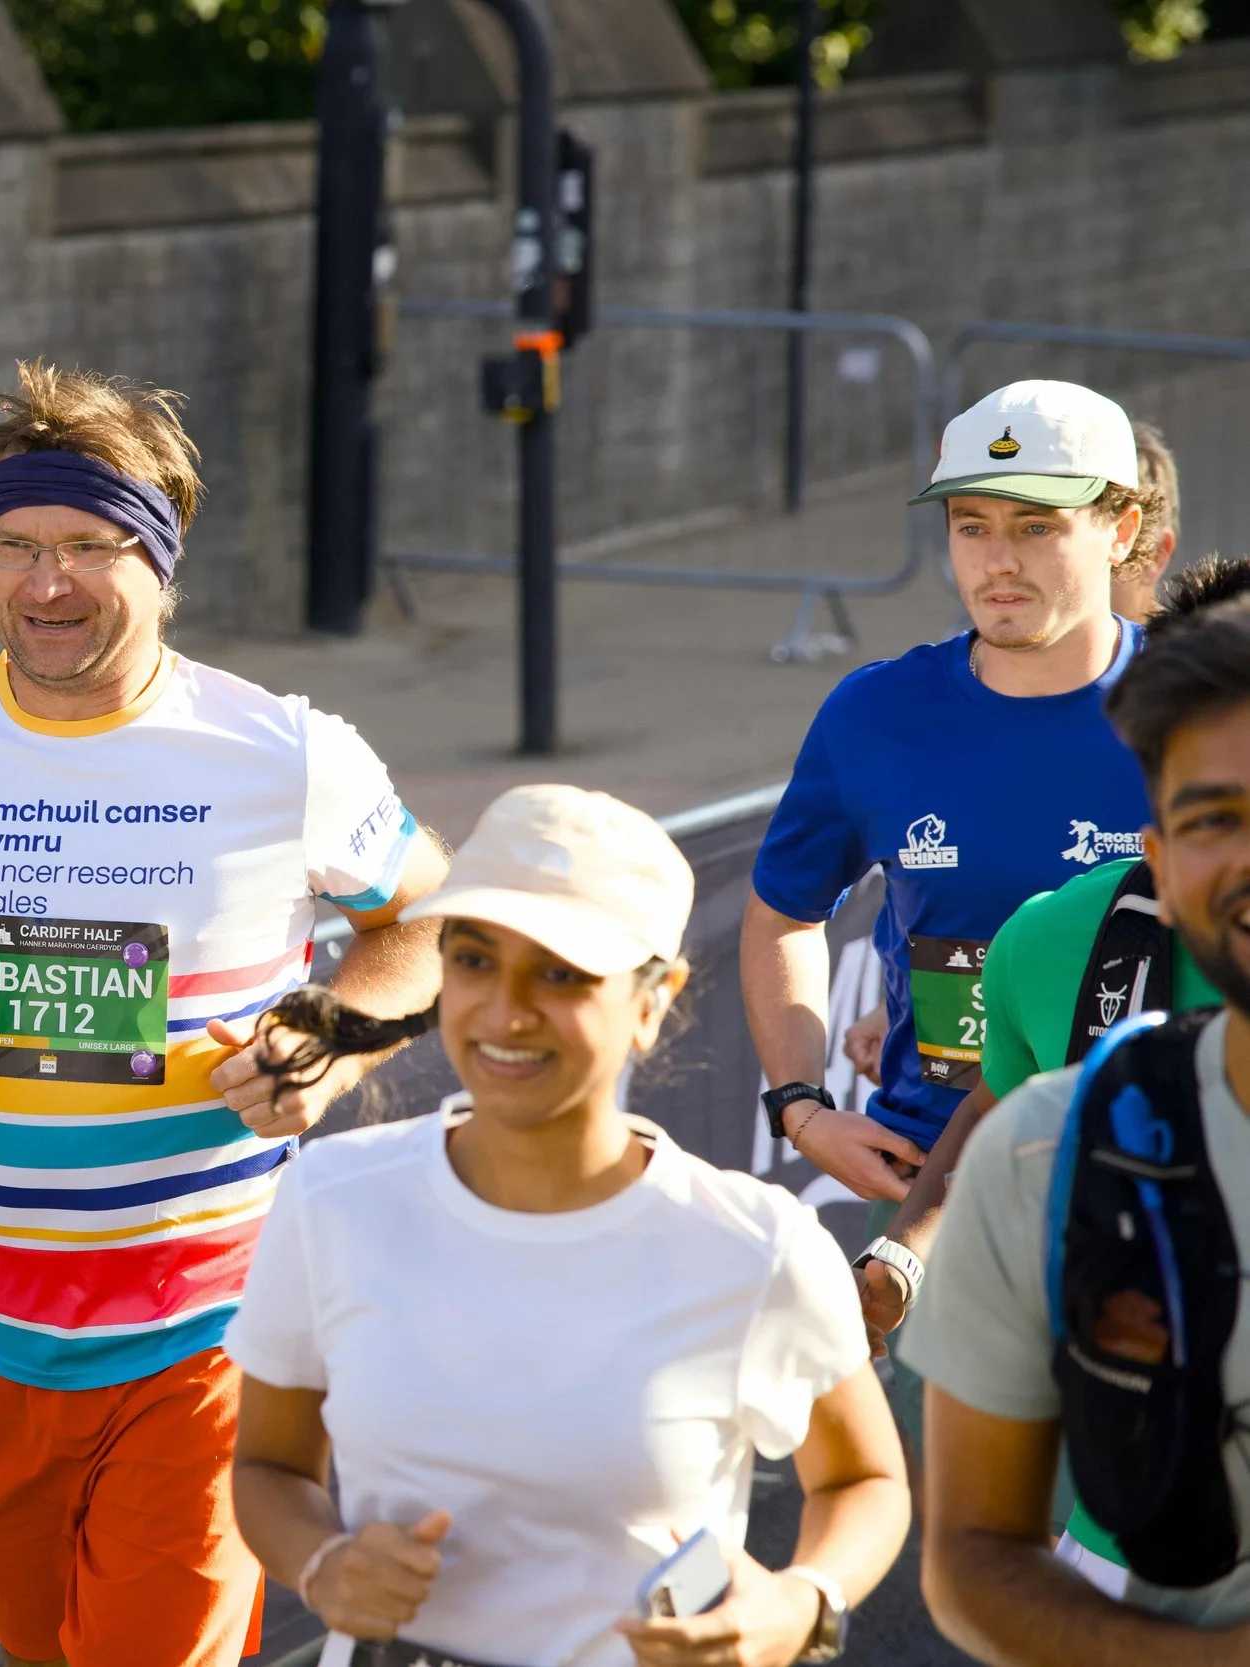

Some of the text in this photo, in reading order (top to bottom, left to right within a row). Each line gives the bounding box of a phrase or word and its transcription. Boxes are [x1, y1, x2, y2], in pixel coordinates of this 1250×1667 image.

[105, 804, 212, 823] canser
[1094, 843, 1145, 854] CYMRU
[899, 850, 958, 866] RHINO
[68, 861, 194, 885] research
[19, 924, 123, 942] CARDIFF HALF
[19, 939, 122, 952] HANNER MARATHON CAERDYDD
[9, 1000, 95, 1035] 1712
[0, 1037, 14, 1045] PEN
[78, 1041, 137, 1051] UNISEX LARGE
